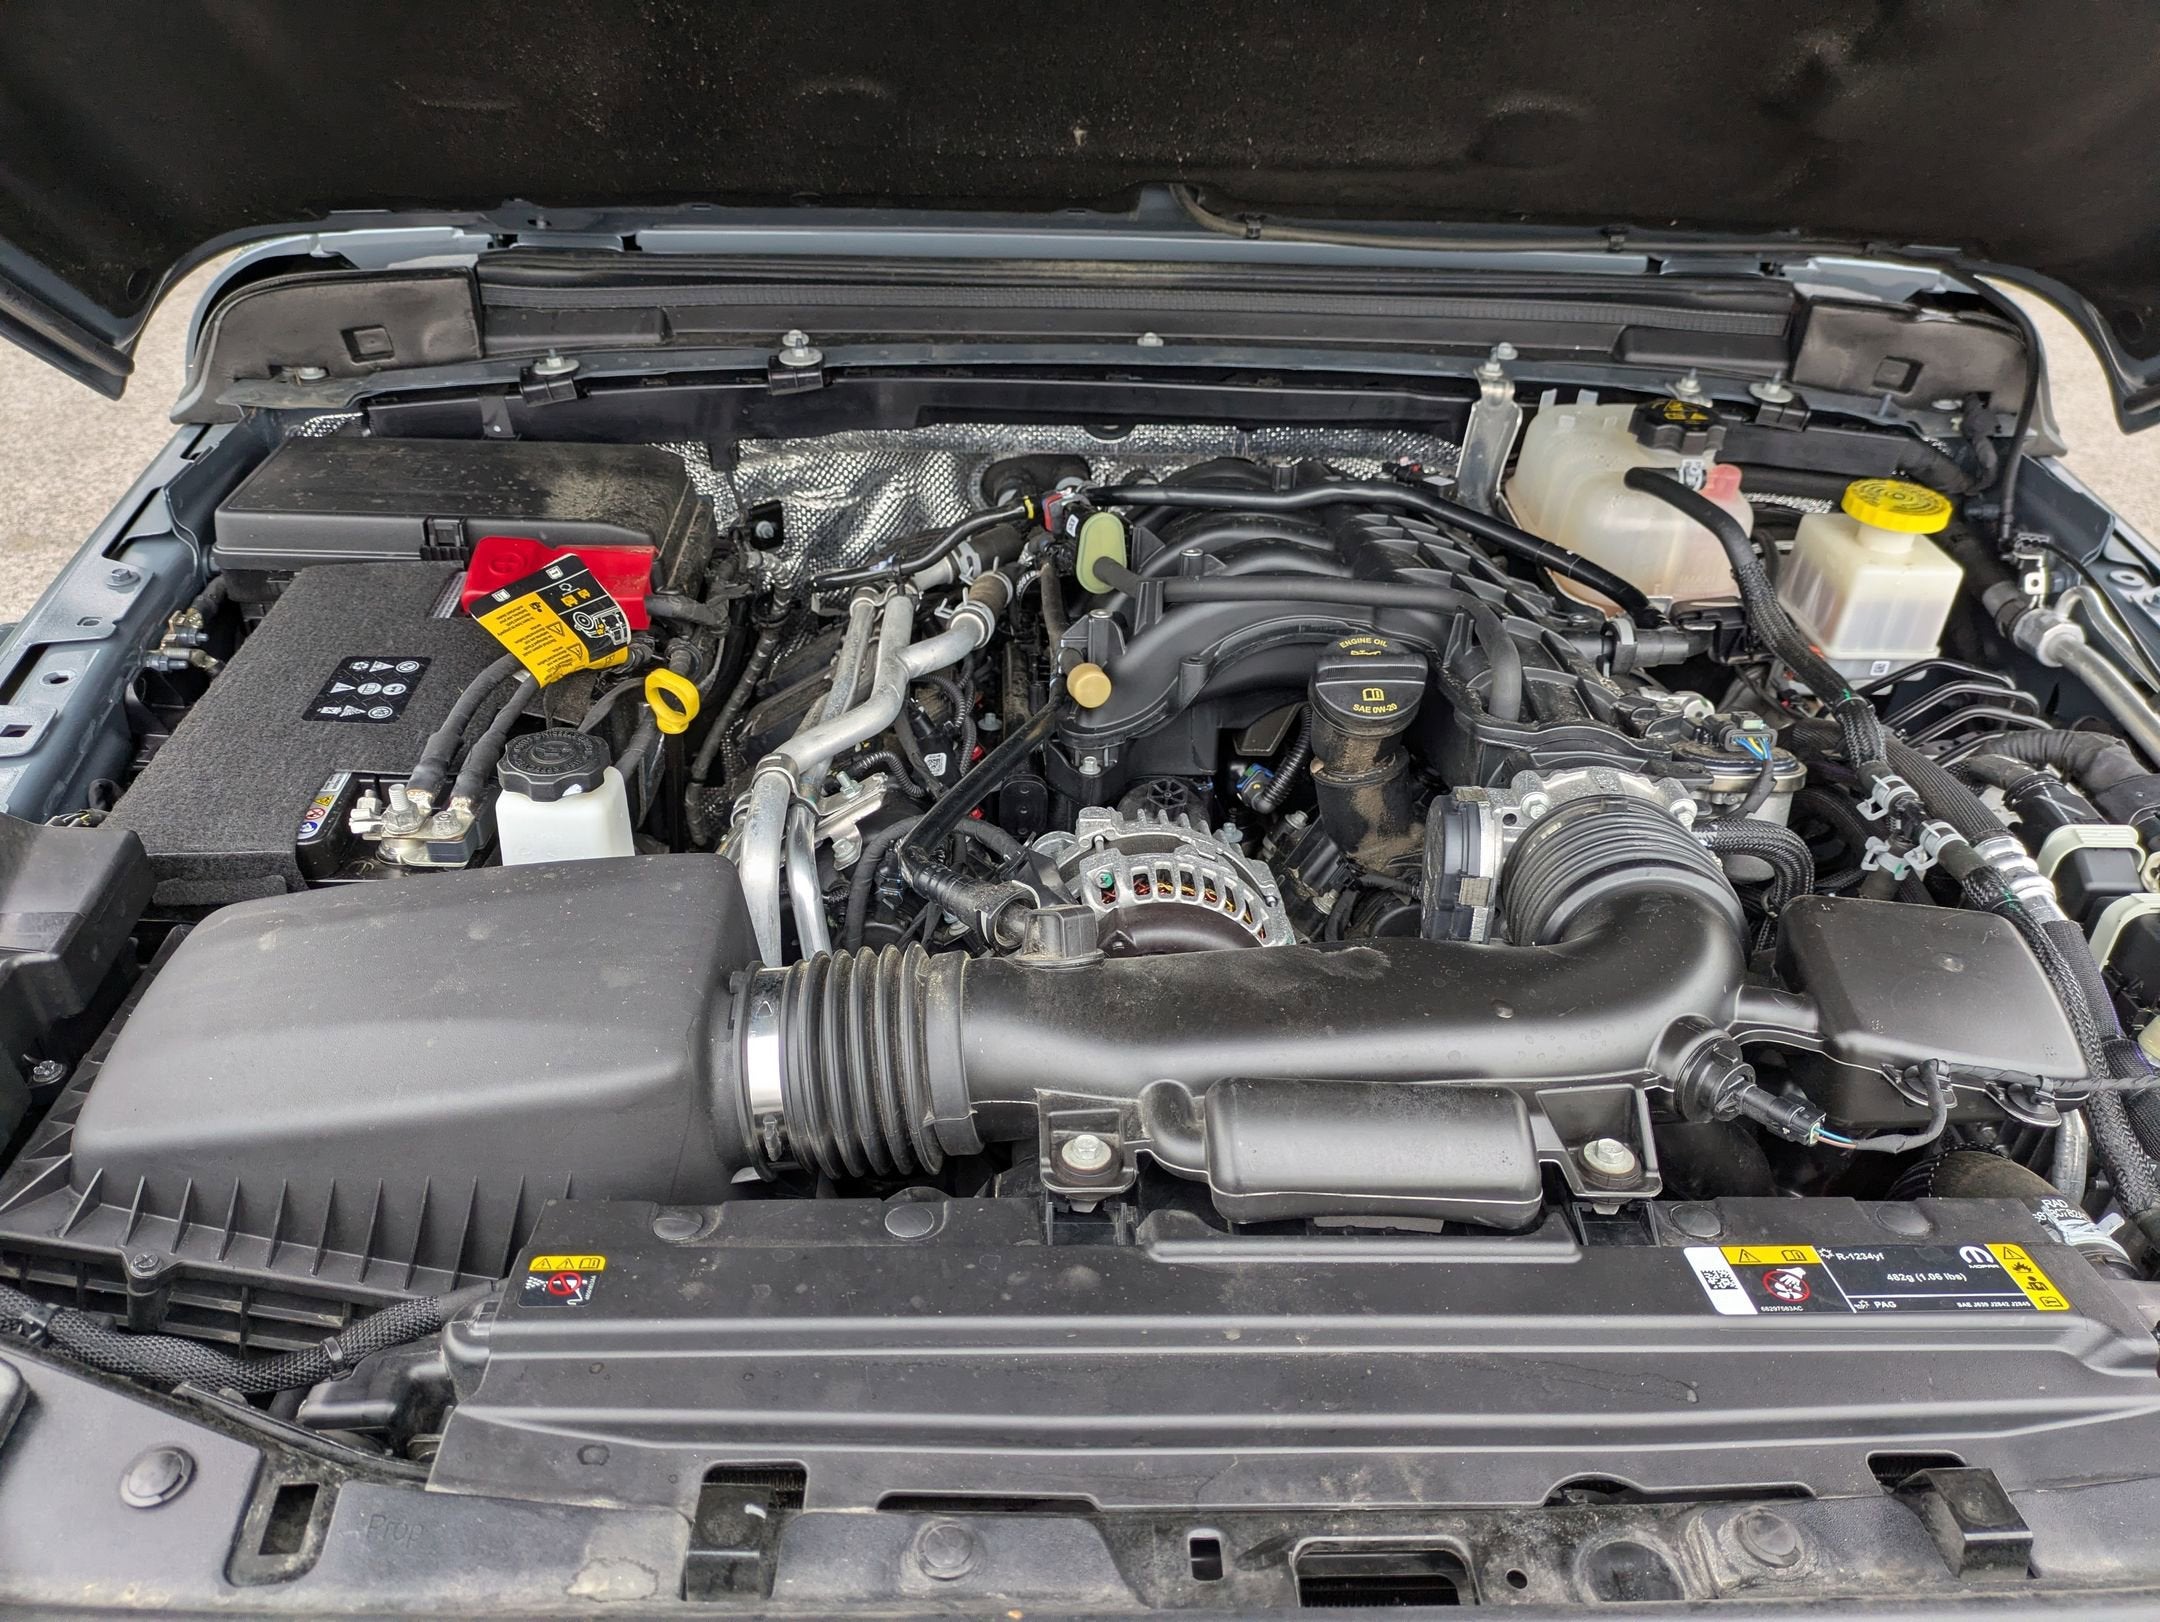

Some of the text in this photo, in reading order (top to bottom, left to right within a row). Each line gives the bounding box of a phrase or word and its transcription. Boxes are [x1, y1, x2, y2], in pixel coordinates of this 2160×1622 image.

[1338, 637, 1388, 649] ENGINE OIL
[1352, 703, 1398, 714] SAE 0W-20
[2041, 1199, 2068, 1209] RAD
[1835, 1252, 1885, 1262] R-1234yf
[1886, 1272, 1968, 1283] 482g (1.06 lbs)
[1873, 1301, 1897, 1309] PAG
[366, 1513, 424, 1549] Prop
